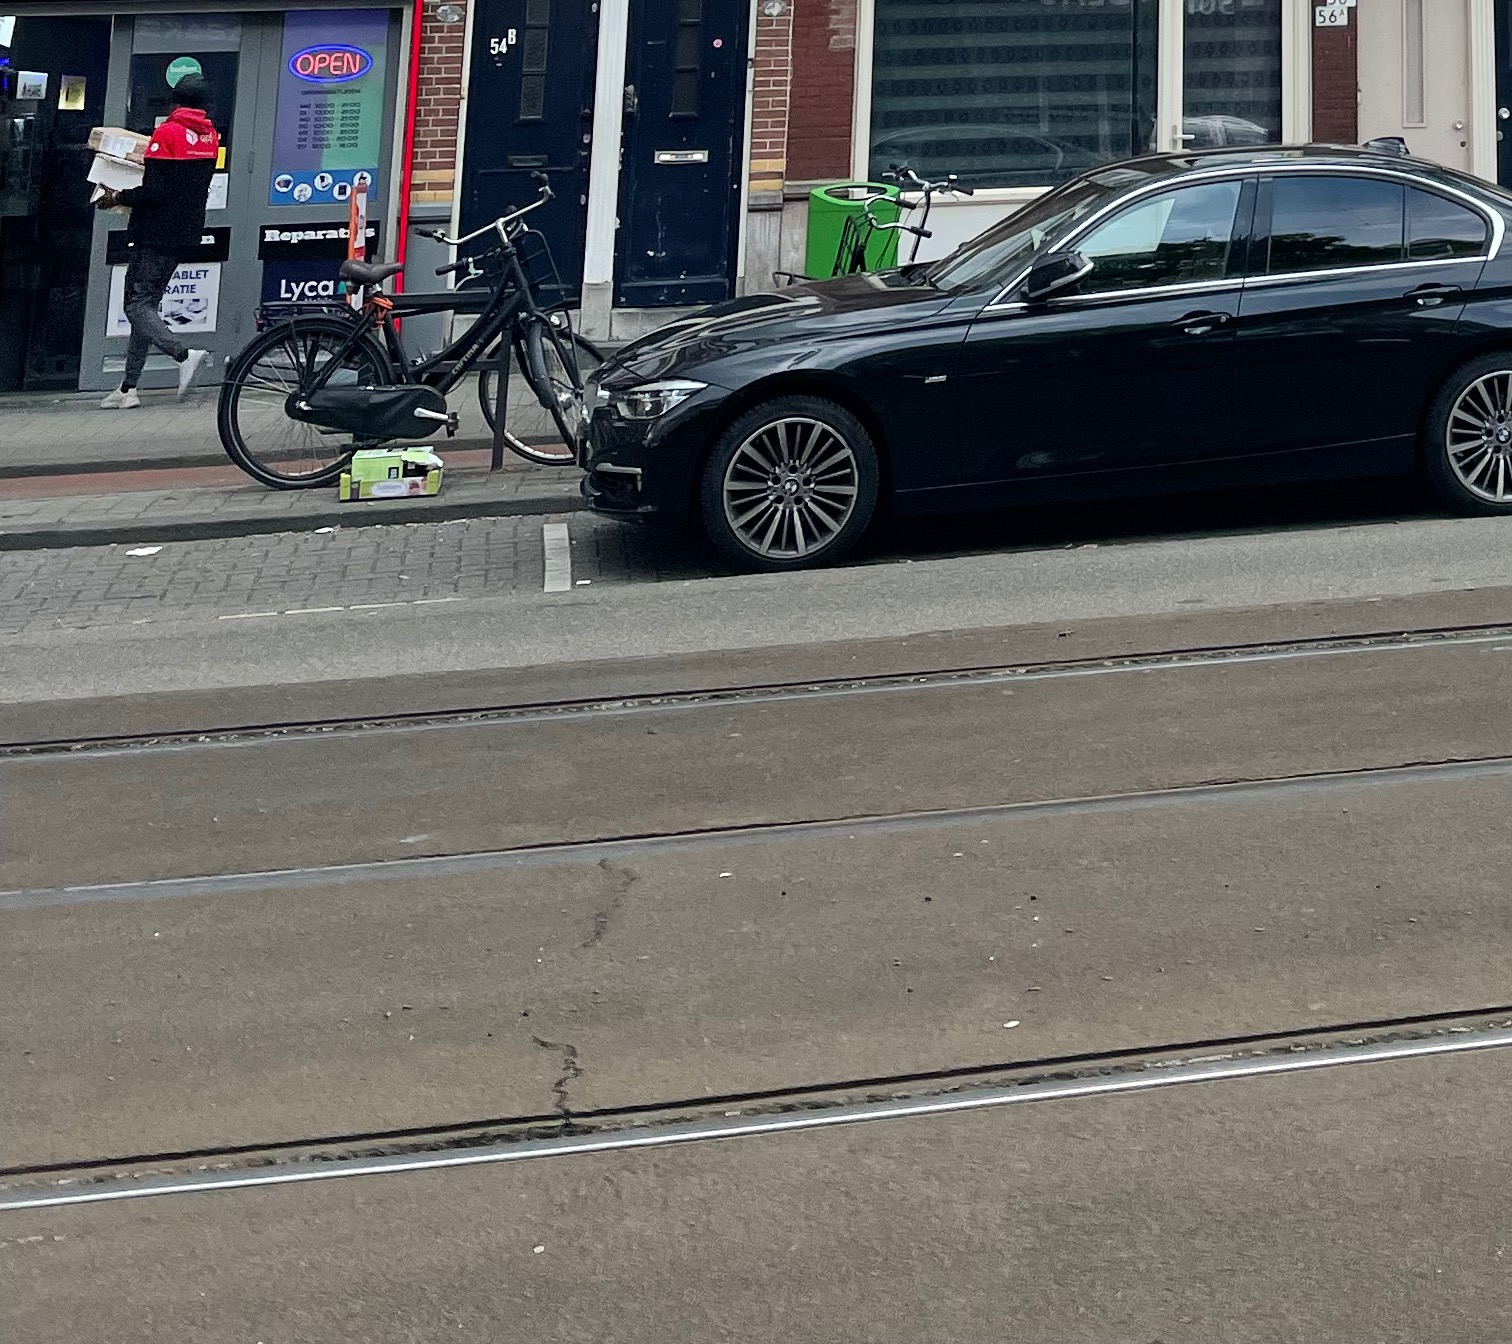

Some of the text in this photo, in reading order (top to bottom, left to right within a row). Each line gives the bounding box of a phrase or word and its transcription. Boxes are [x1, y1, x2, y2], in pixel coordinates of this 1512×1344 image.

[296, 52, 360, 75] OPEN
[263, 228, 375, 243] Reparats
[172, 269, 209, 280] ABLET
[280, 279, 334, 302] Lyca
